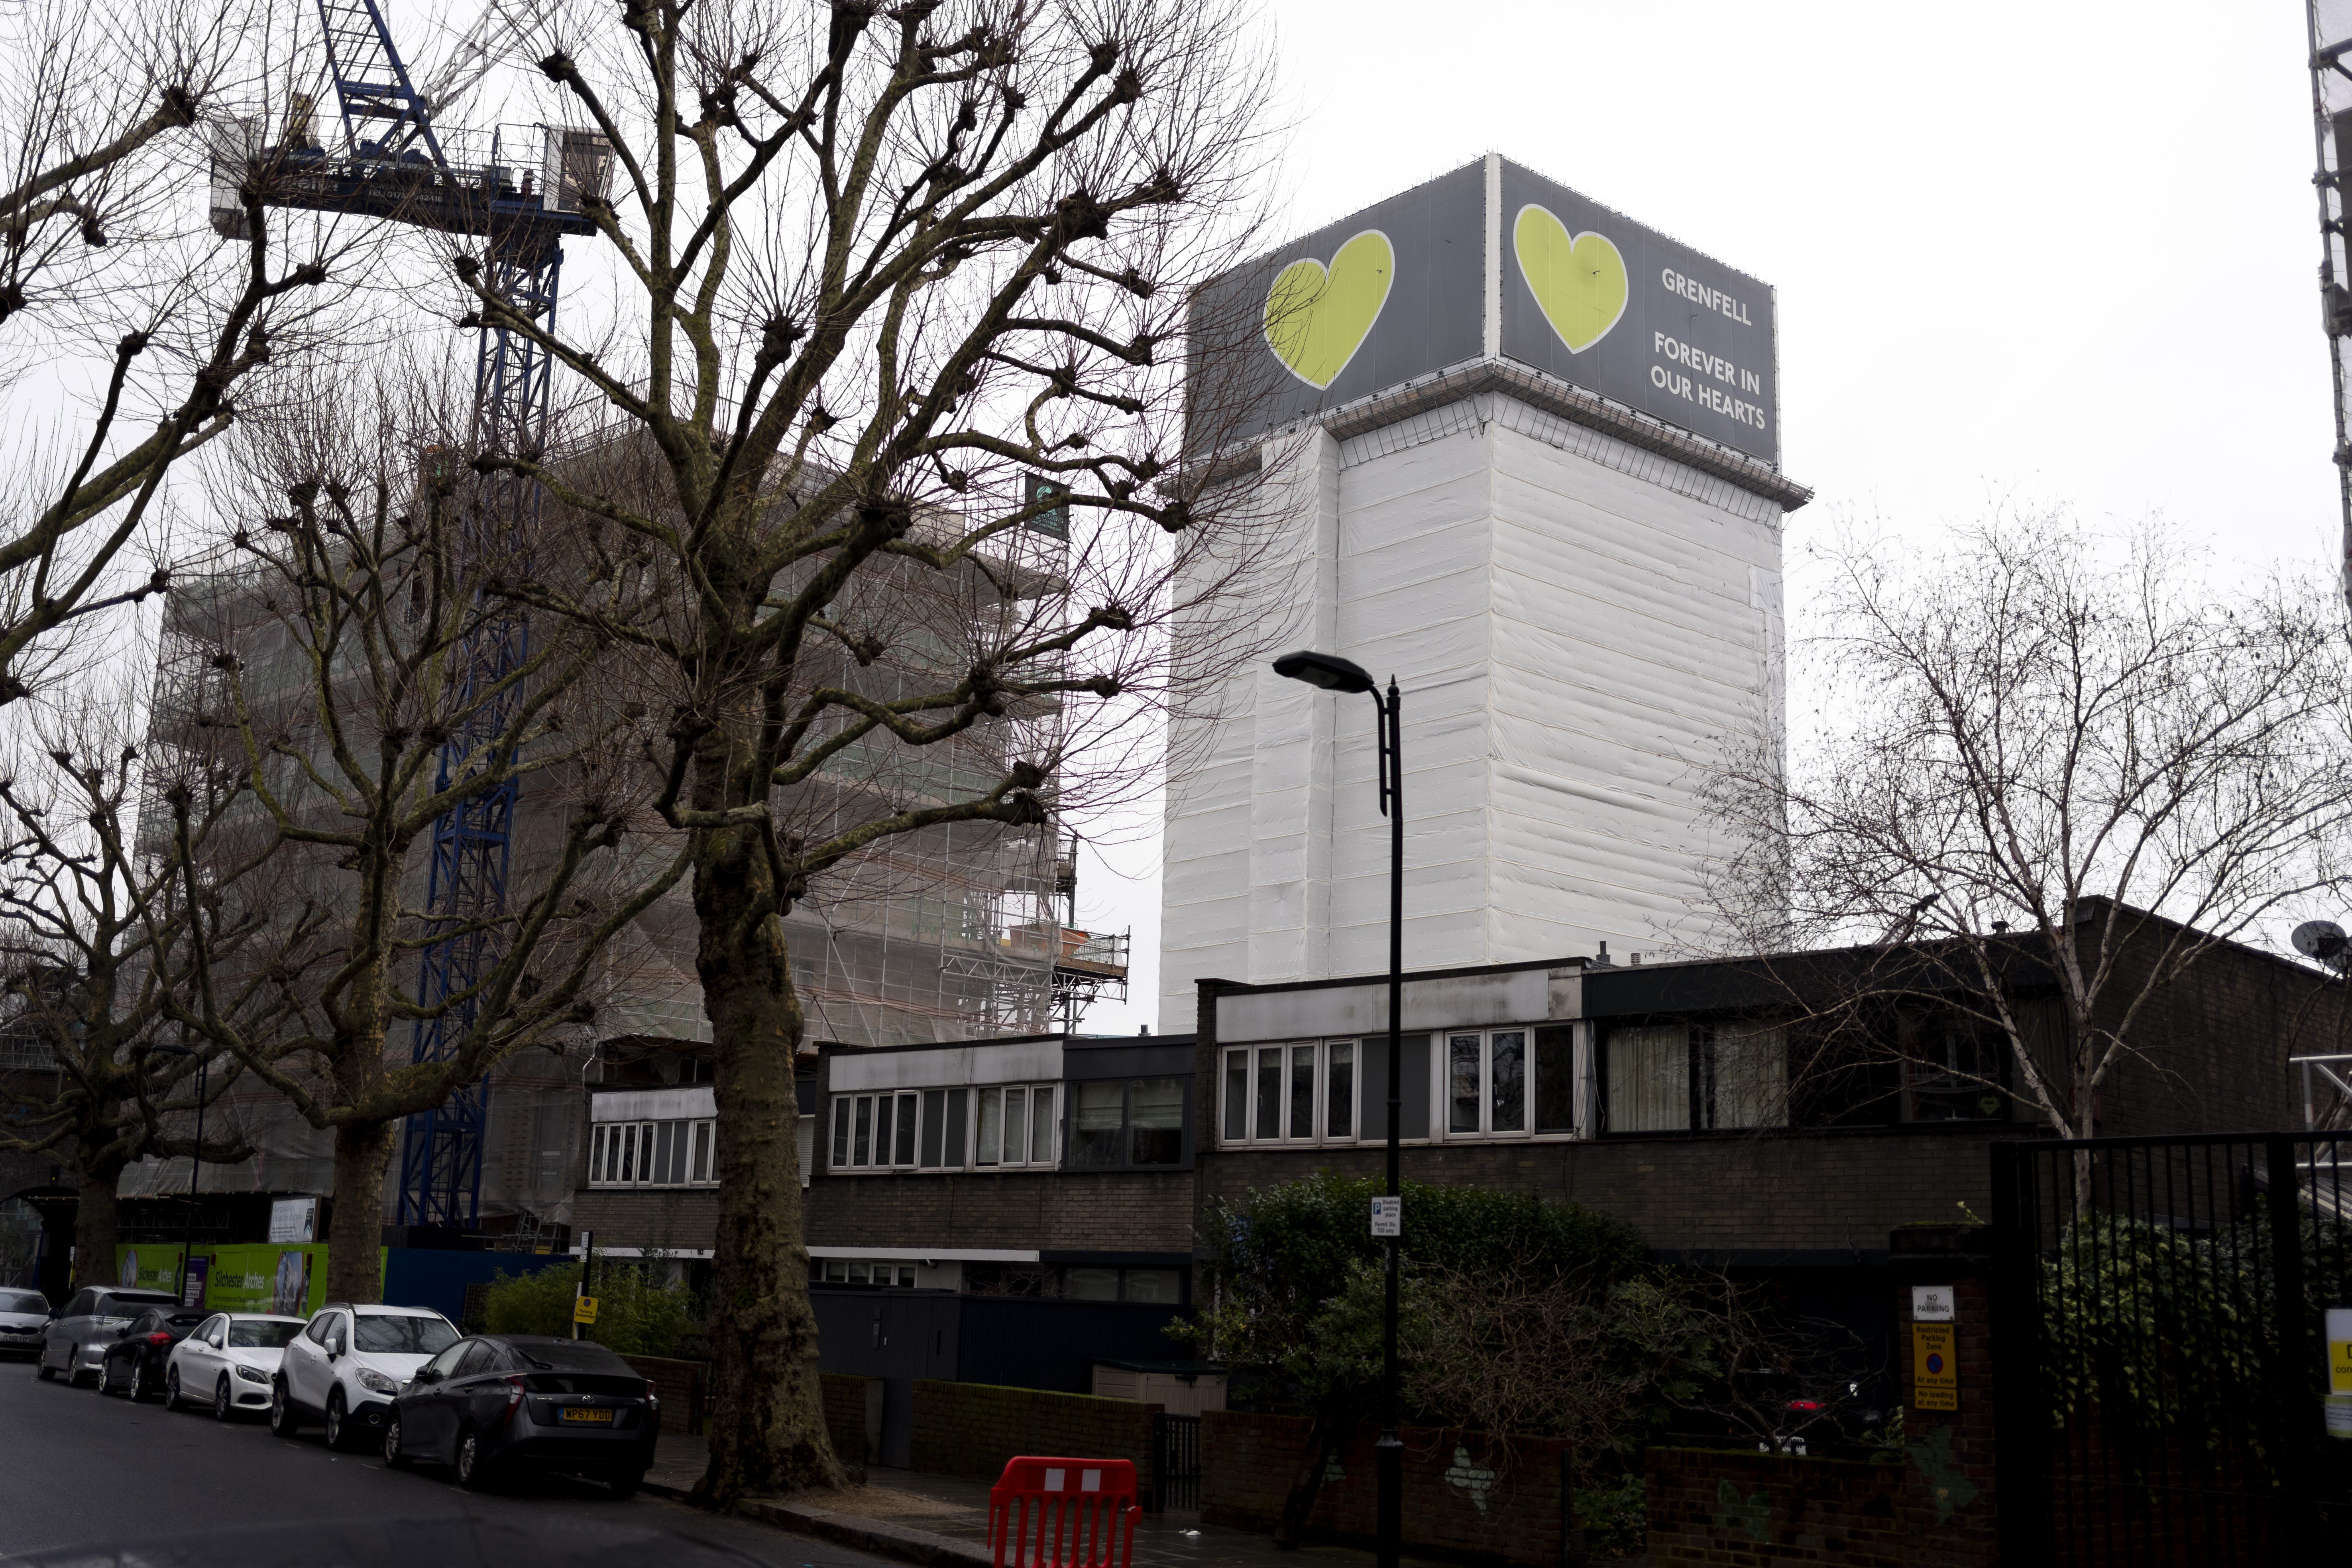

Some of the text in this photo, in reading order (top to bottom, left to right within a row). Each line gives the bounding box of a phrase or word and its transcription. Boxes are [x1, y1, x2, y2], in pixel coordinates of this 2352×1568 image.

[1662, 268, 1752, 326] GRENFELL
[1655, 331, 1759, 395] FOREVER IN
[1651, 365, 1765, 429] OUR HEARTS
[138, 1266, 159, 1281] Silchester
[214, 1270, 265, 1289] Silchester Arches
[1930, 1391, 1953, 1399] loading
[566, 1409, 610, 1419] WP67 YDD
